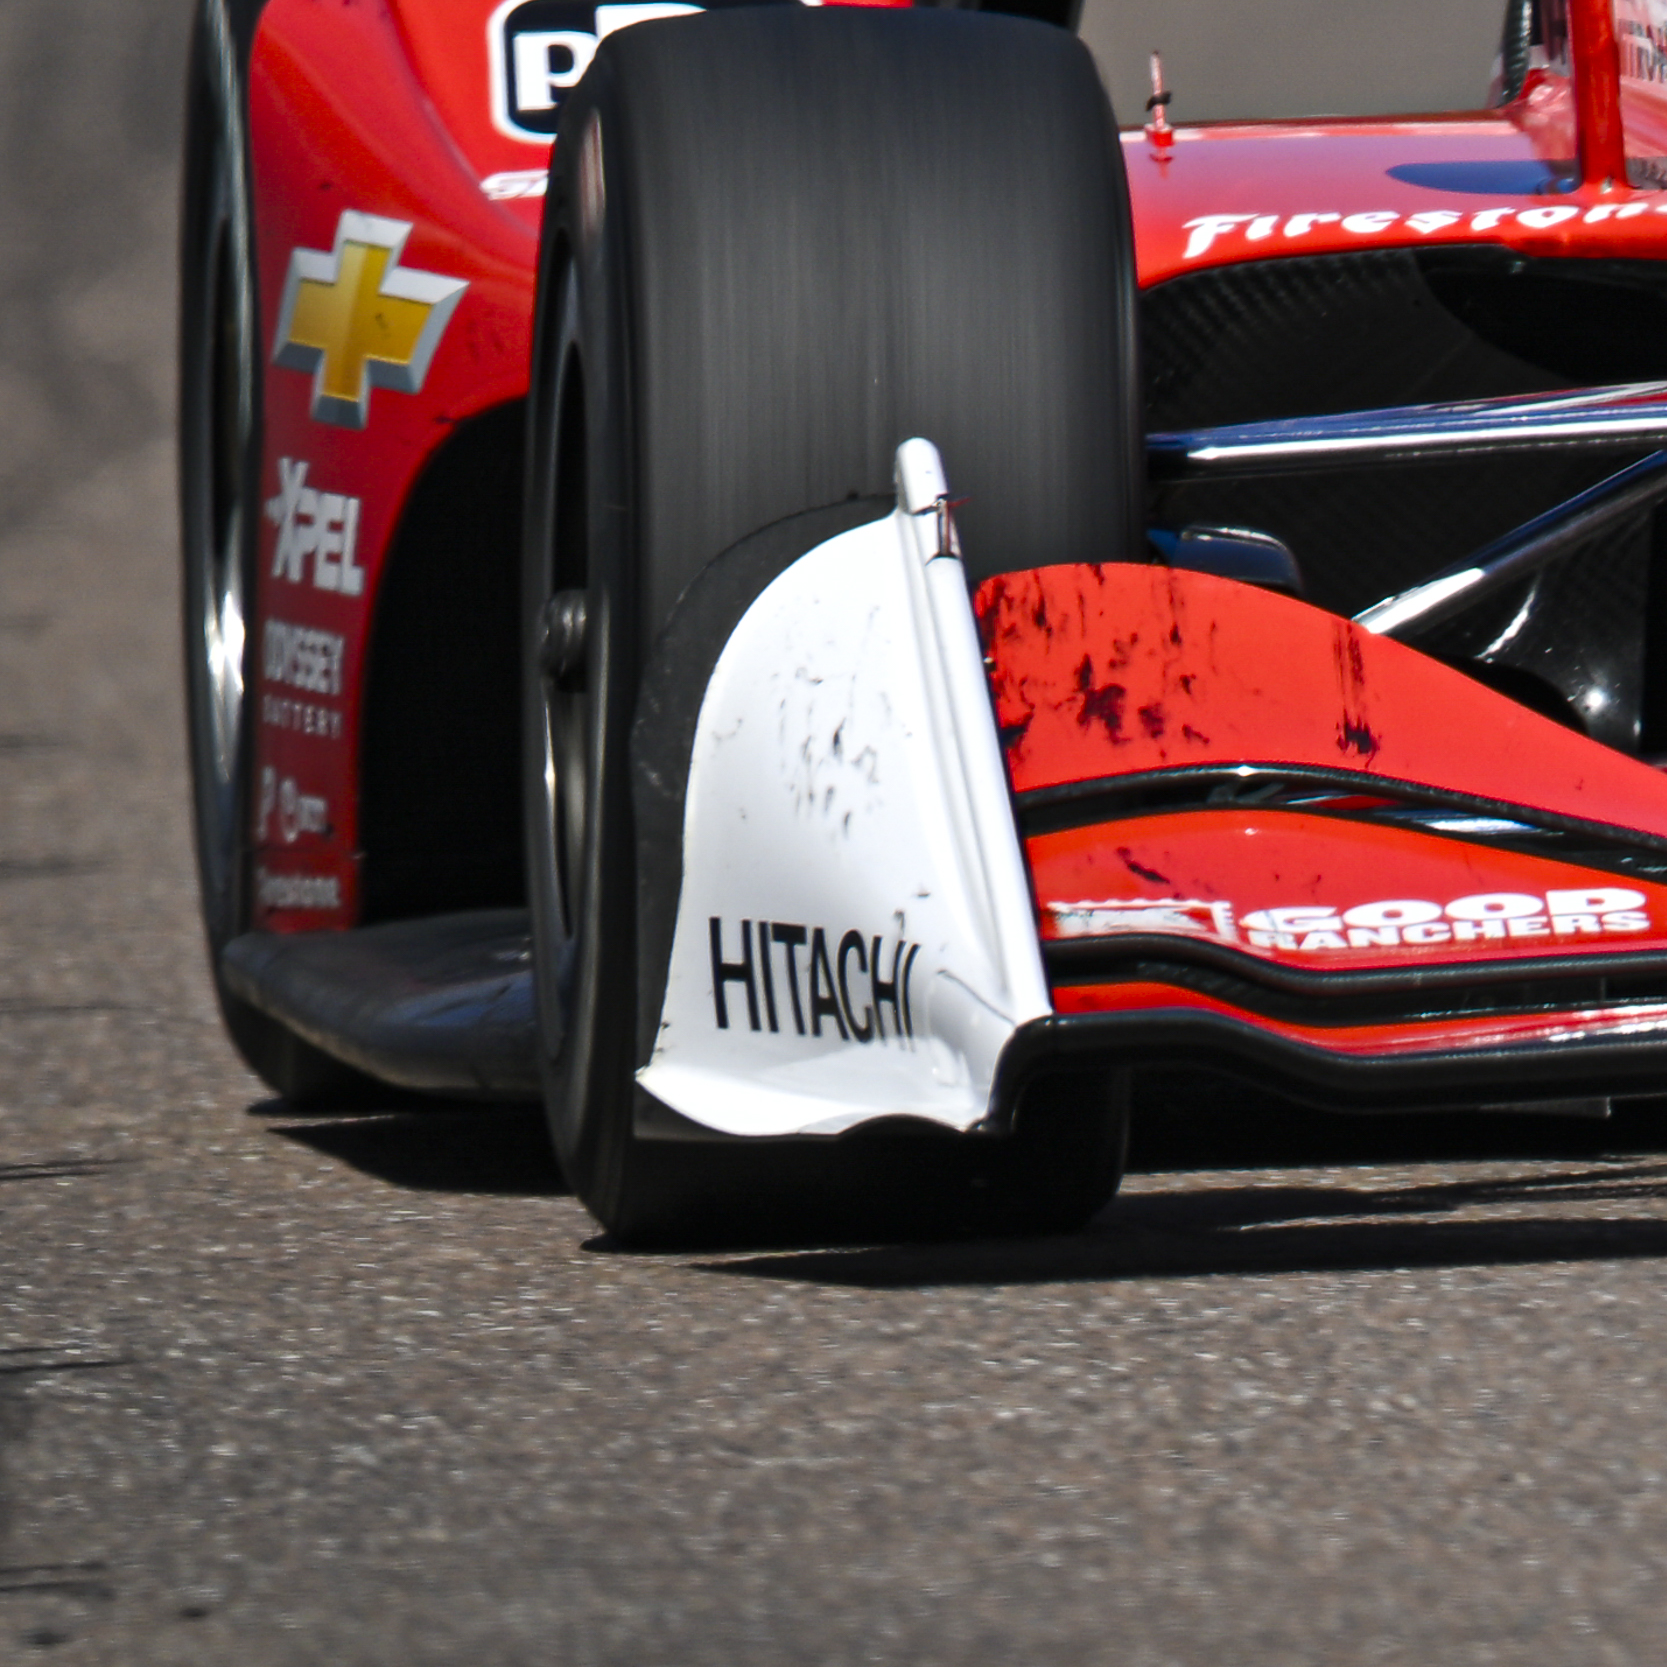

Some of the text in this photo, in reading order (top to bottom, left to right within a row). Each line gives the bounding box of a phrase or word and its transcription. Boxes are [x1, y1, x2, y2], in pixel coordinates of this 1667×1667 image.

[264, 455, 366, 597] XPEL
[1238, 888, 1648, 933] GOOD
[1246, 911, 1650, 950] RANCHERS
[709, 916, 922, 1051] HITACHI
